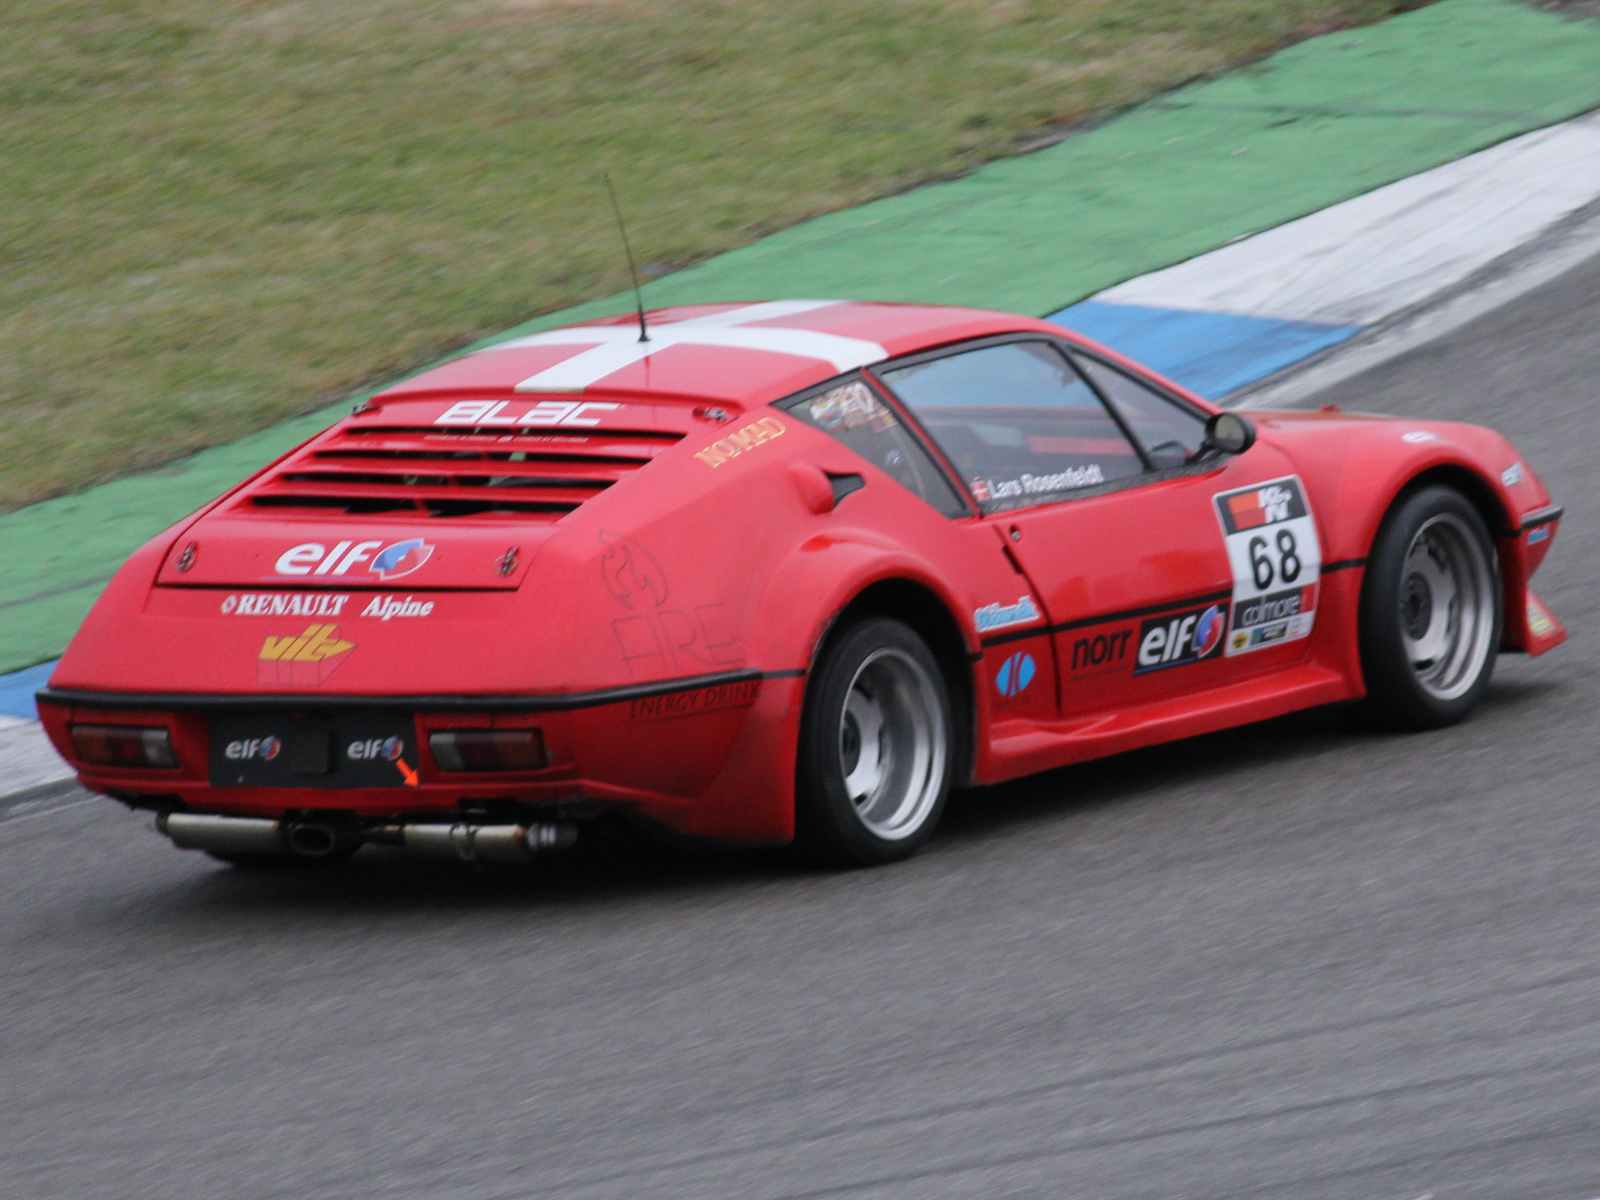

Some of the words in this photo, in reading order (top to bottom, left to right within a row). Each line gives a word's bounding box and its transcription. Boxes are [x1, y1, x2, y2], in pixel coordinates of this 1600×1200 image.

[693, 416, 786, 469] NOMAD
[275, 540, 383, 575] elf
[1249, 529, 1301, 591] 68
[234, 594, 350, 616] RENAULT
[359, 595, 435, 622] Alpine
[1138, 614, 1198, 667] elf
[704, 681, 761, 708] DRINK
[225, 738, 261, 760] elf
[346, 738, 384, 760] elf
